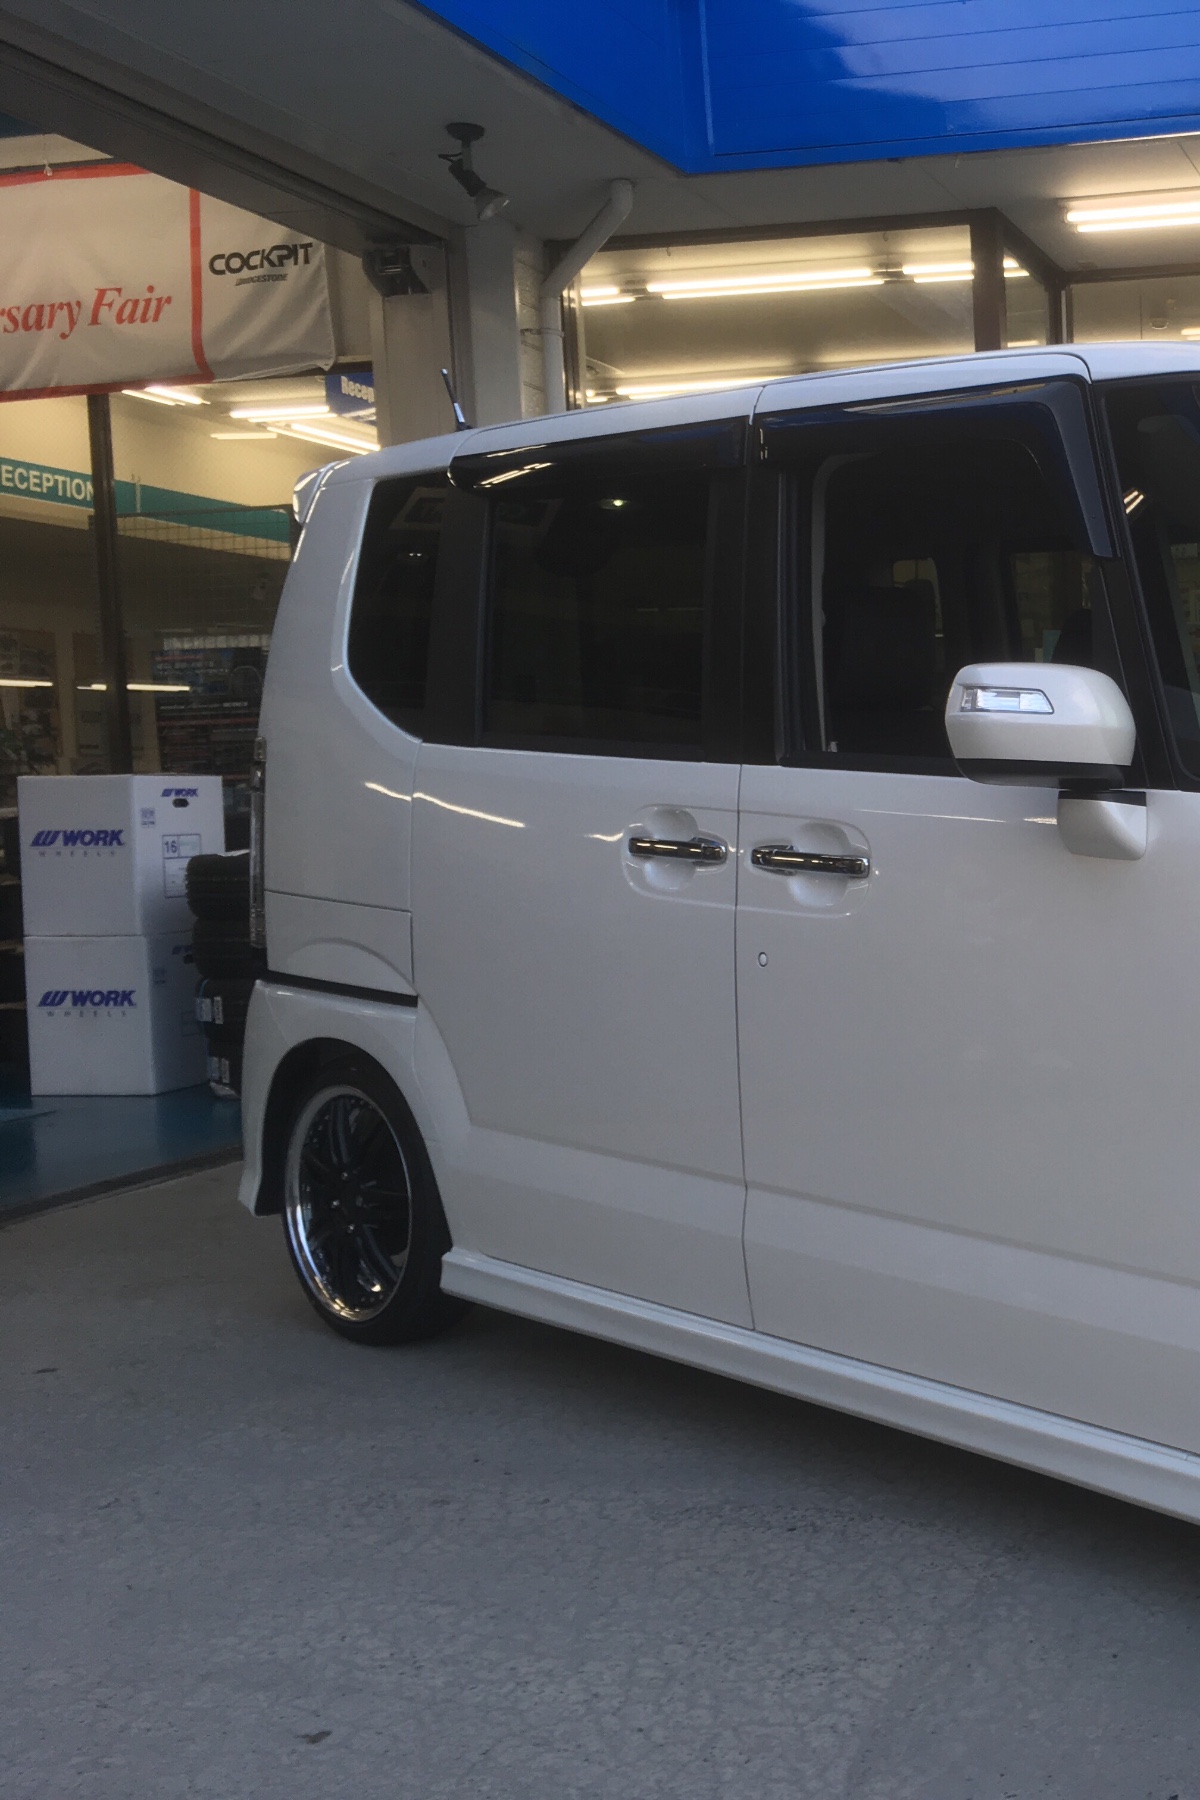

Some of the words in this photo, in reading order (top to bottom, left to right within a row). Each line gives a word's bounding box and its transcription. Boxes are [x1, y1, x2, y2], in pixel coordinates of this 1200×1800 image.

[208, 242, 313, 276] COCKPIT
[0, 300, 82, 340] sary
[88, 285, 172, 327] Fair
[61, 829, 125, 847] WORK
[70, 990, 137, 1008] WORK
